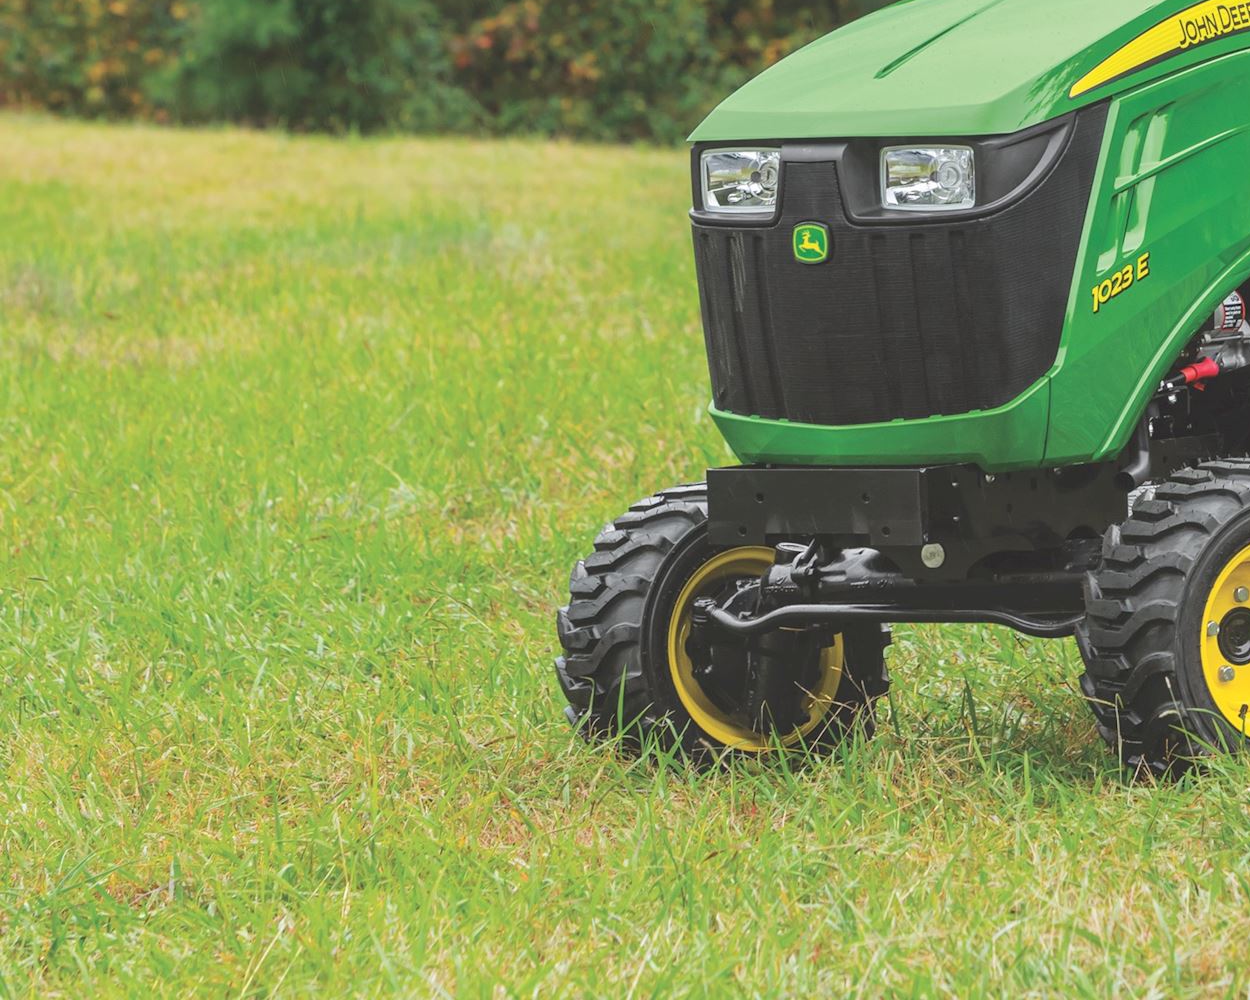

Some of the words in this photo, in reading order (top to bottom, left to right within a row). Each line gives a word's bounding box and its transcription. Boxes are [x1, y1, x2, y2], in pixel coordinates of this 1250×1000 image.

[1178, 12, 1218, 45] JOHN
[1091, 263, 1134, 313] 1023
[1136, 251, 1150, 281] E
